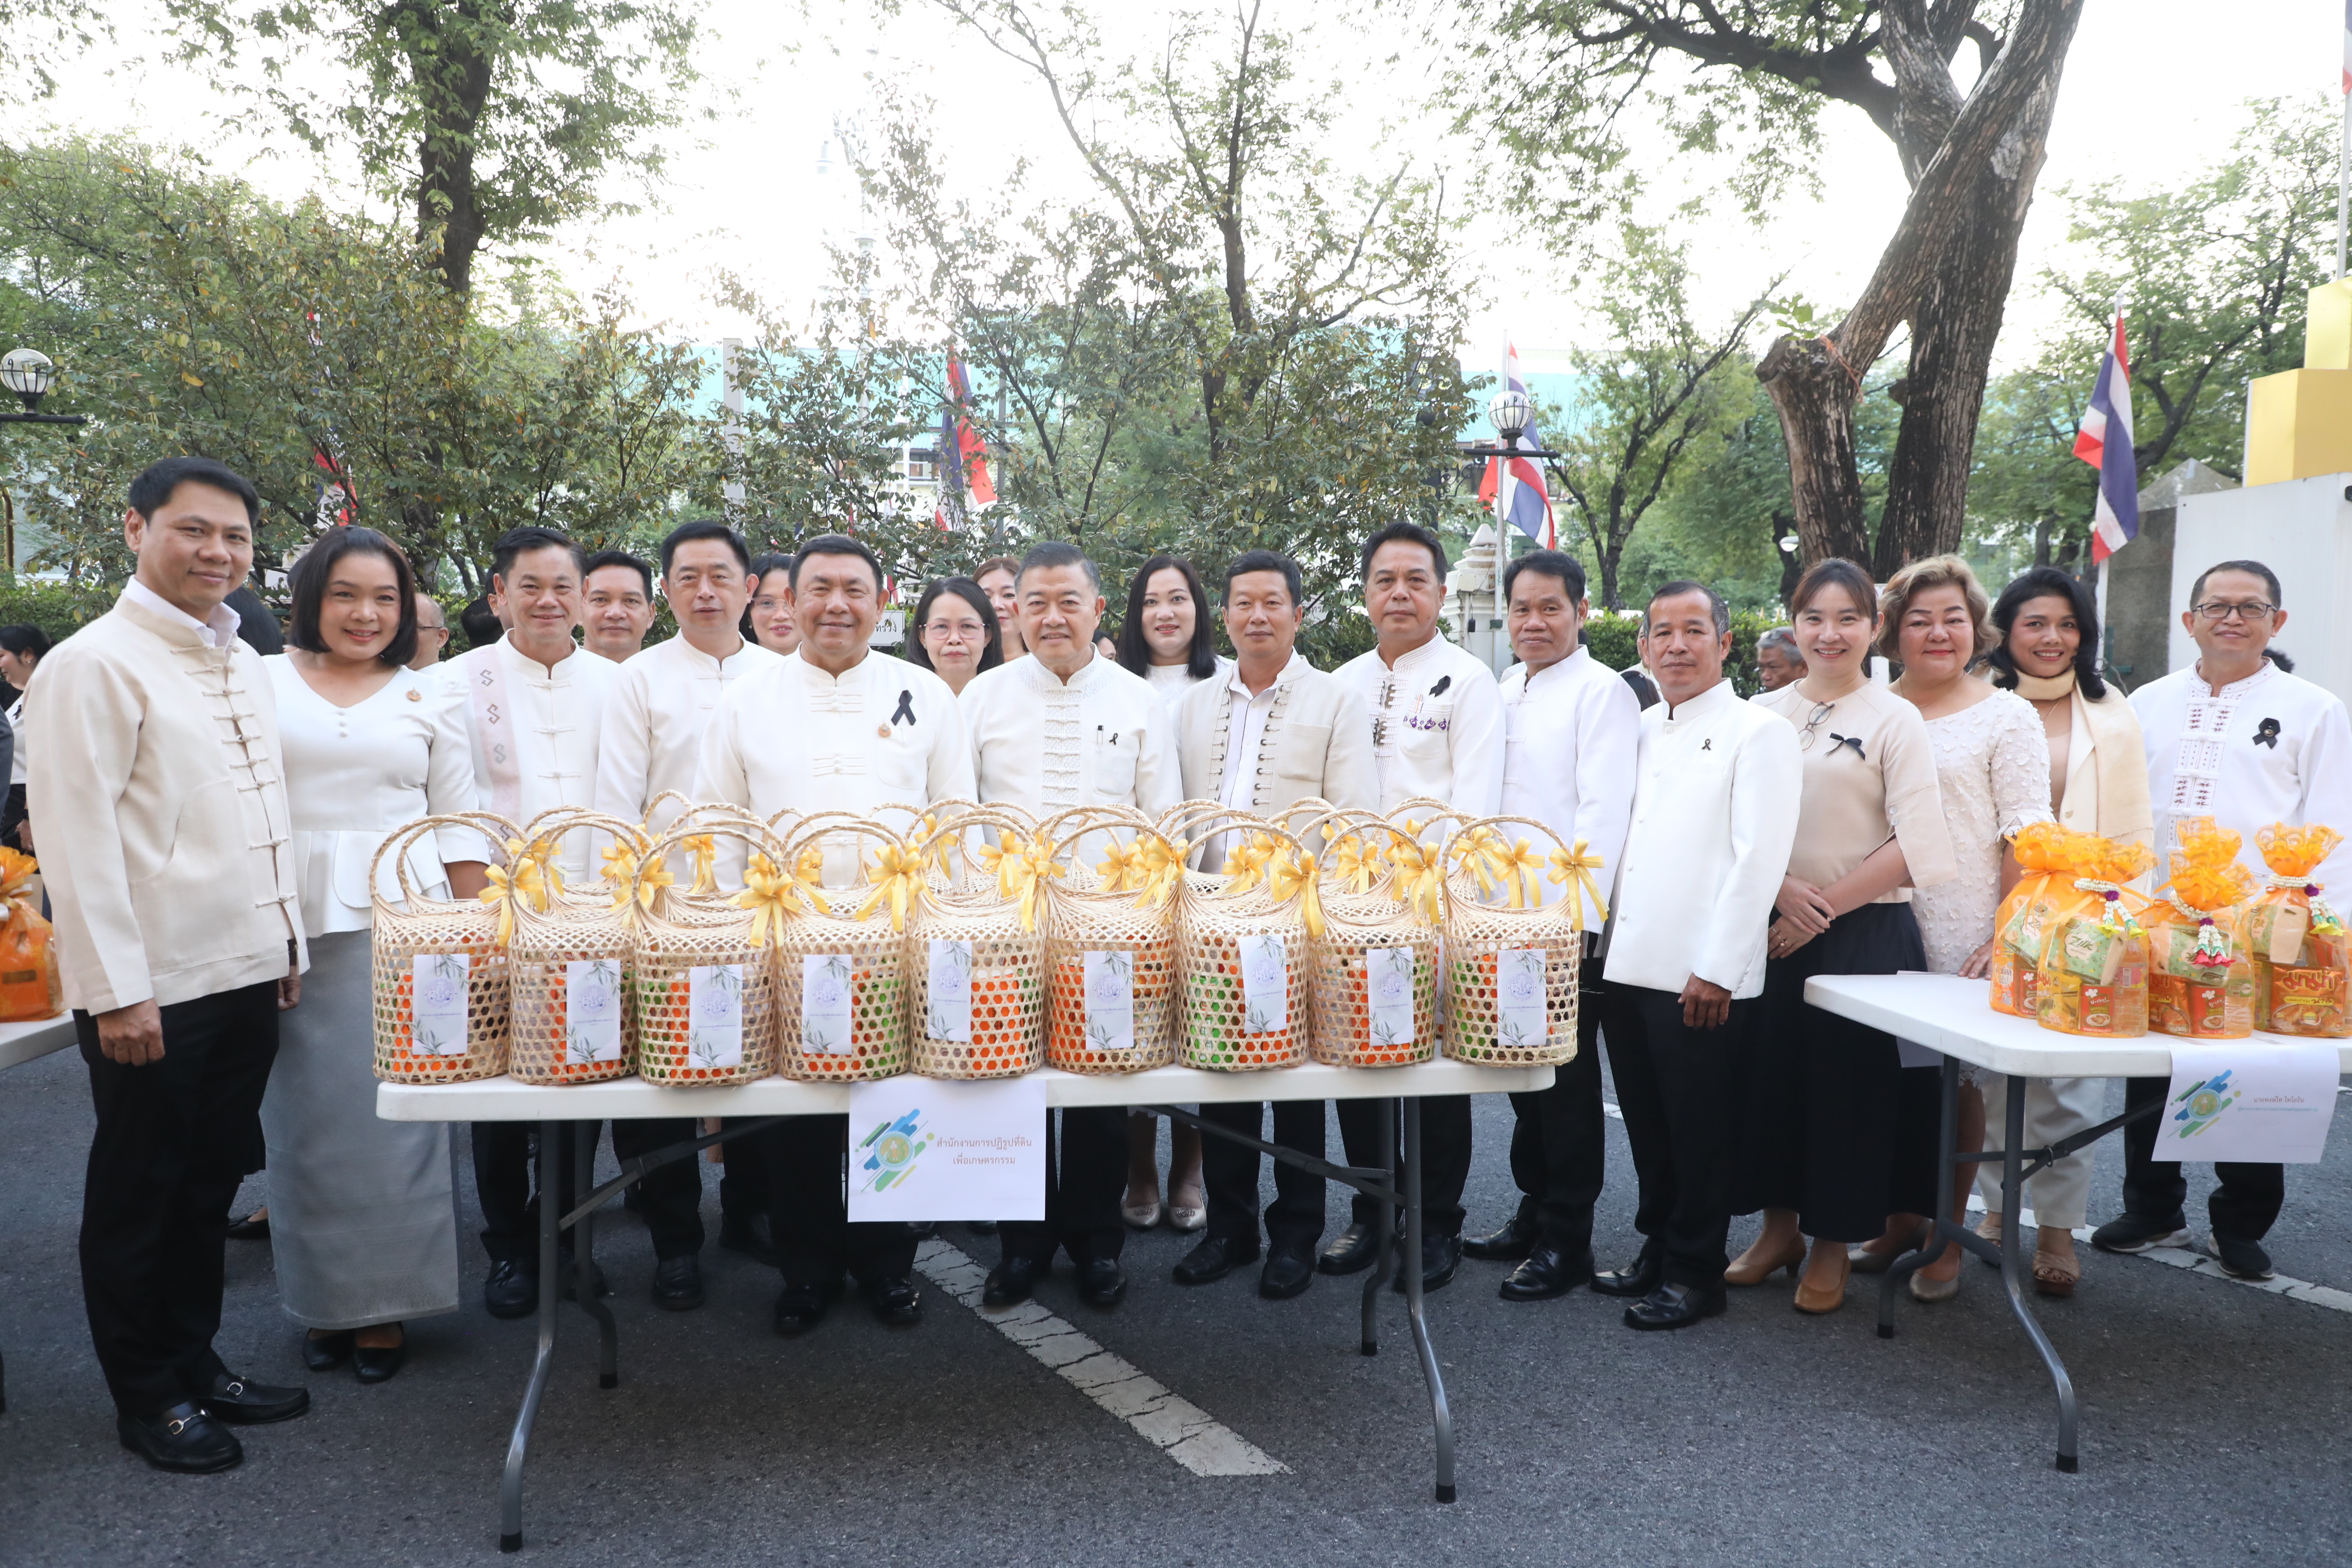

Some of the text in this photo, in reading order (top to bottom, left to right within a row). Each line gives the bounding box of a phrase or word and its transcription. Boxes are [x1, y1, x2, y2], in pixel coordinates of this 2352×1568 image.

[2282, 969, 2335, 992] มาม่า
[936, 1134, 1032, 1151] สำนักงานการปฏิรูปที่ดิน
[953, 1152, 1016, 1165] เพื่อเกษตรกรรม
